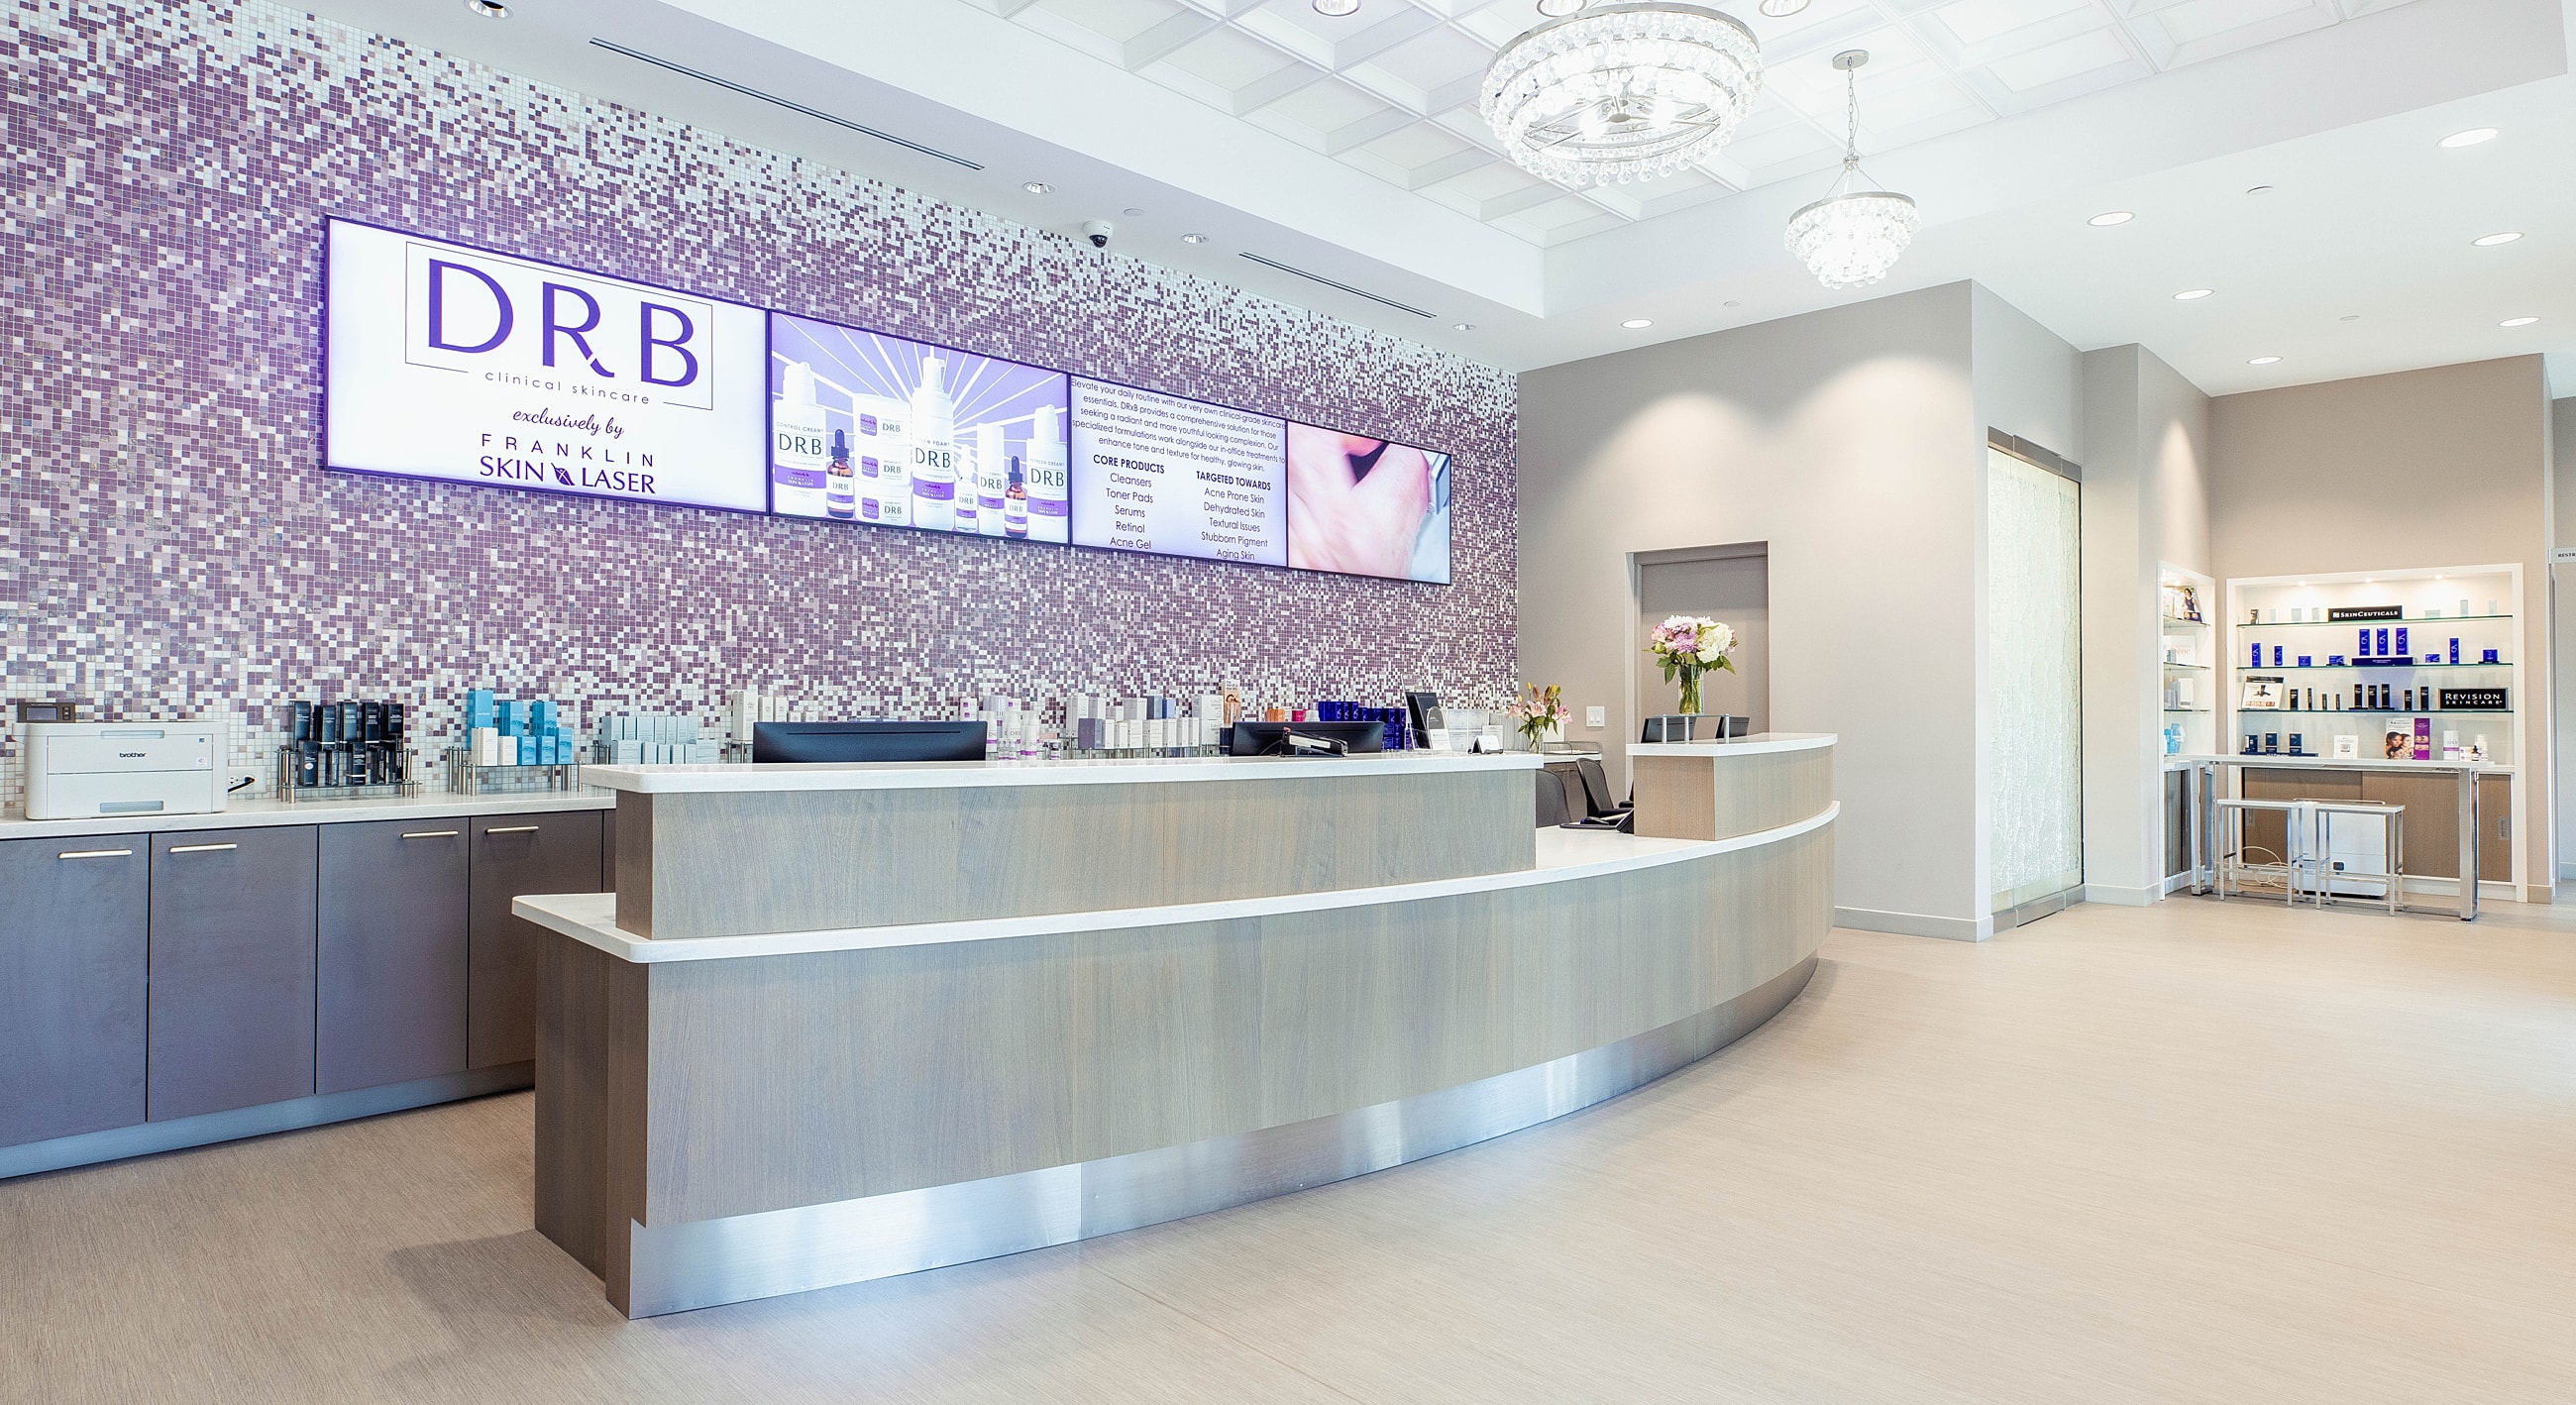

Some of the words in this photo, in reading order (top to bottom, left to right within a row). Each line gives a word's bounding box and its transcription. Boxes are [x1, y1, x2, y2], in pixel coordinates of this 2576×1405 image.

[428, 258, 698, 387] DRB
[484, 372, 561, 391] clinical
[572, 384, 650, 405] skincare
[1071, 378, 1099, 391] Elevate
[1118, 389, 1134, 399] daily
[1135, 393, 1160, 404] routine
[1161, 398, 1175, 407] with
[1189, 404, 1203, 413] very
[1220, 410, 1260, 424] clinical-grade
[1262, 418, 1285, 429] skincare
[512, 407, 601, 436] exclusively
[605, 417, 624, 439] by
[882, 423, 901, 433] DRB
[1080, 407, 1109, 421] seeking
[1117, 414, 1142, 425] radiant
[1144, 420, 1158, 429] and
[1179, 427, 1205, 437] youthful
[1206, 431, 1229, 443] looking
[1267, 442, 1279, 451] Our
[1121, 401, 1138, 412] DRxB
[1139, 405, 1168, 418] provides
[1176, 414, 1226, 429] comprehensive
[1228, 424, 1249, 434] solution
[1250, 427, 1259, 436] for
[1260, 430, 1277, 439] those
[779, 433, 822, 455] DRB
[1072, 419, 1114, 433] specialized
[1115, 425, 1157, 441] formulations
[1158, 434, 1174, 444] work
[1175, 438, 1207, 450] alongside
[1220, 445, 1245, 456] in-office
[1246, 451, 1278, 463] treatments
[482, 433, 653, 468] FRANKLIN
[915, 447, 951, 469] DRB
[1098, 437, 1131, 449] enhance
[1132, 442, 1149, 452] tone
[1150, 446, 1165, 455] and
[1166, 448, 1190, 459] texture
[1191, 452, 1200, 461] for
[1228, 459, 1251, 472] glowing
[883, 465, 902, 474] DRB
[1093, 454, 1119, 467] CORE
[1121, 458, 1165, 474] PRODUCTS
[480, 455, 544, 483] SKIN
[582, 467, 656, 494] LASER
[980, 477, 1003, 489] DRB
[1030, 468, 1065, 486] DRB
[1110, 473, 1152, 487] Cleansers
[1196, 471, 1234, 485] TARGETED
[1235, 477, 1271, 491] TOWARDS
[1106, 487, 1130, 500] Toner
[1132, 491, 1154, 503] Pads
[1204, 486, 1226, 498] Acne
[1227, 489, 1249, 502] Prone
[1250, 493, 1264, 504] Skin
[884, 505, 903, 514] DRB
[1115, 504, 1146, 517] Serums
[1204, 501, 1250, 516] Dehydrated
[1251, 507, 1265, 518] Skin
[1116, 520, 1145, 533] Retinol
[1209, 516, 1238, 530] Textural
[1239, 521, 1260, 533] Issues
[1110, 536, 1134, 548] Acne
[1135, 538, 1151, 550] Gel
[1201, 530, 1236, 544] Stubborn
[1237, 535, 1268, 548] Pigment
[1217, 548, 1239, 561] Aging
[1240, 550, 1255, 561] Skin
